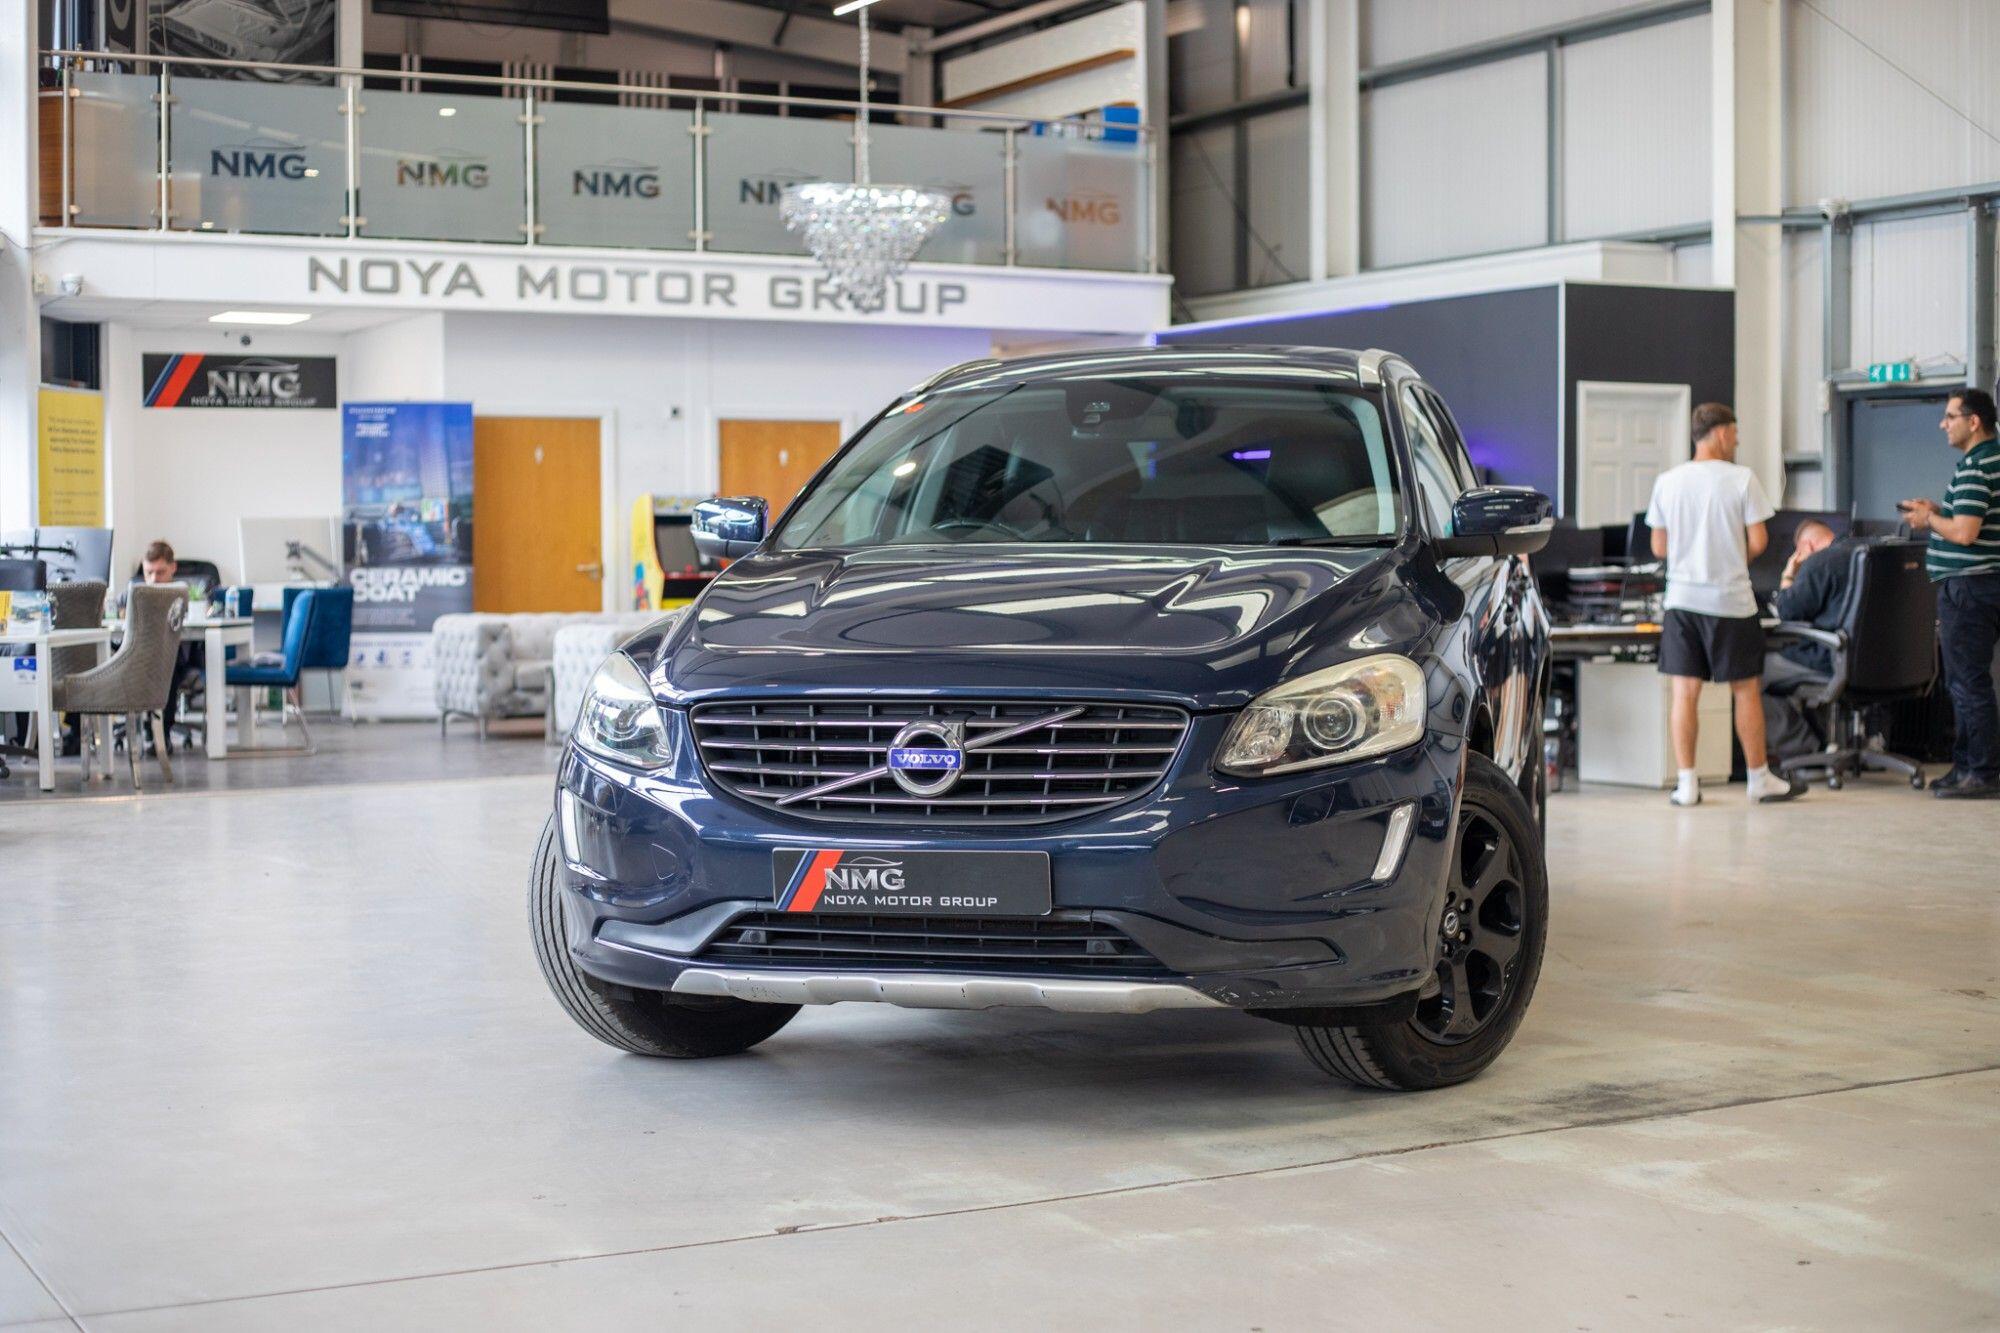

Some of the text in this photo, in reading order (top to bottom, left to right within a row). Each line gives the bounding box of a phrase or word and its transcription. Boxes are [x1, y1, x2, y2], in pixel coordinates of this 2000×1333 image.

[210, 150, 308, 180] NMG
[397, 160, 489, 188] NMG
[572, 170, 661, 199] NMG
[308, 256, 484, 298] NOYA
[517, 264, 737, 307] MOTOR
[207, 370, 302, 398] NMG
[894, 753, 957, 765] VOLVO
[824, 868, 906, 891] NMG
[824, 894, 998, 908] NOYA MOTOR GROUP
